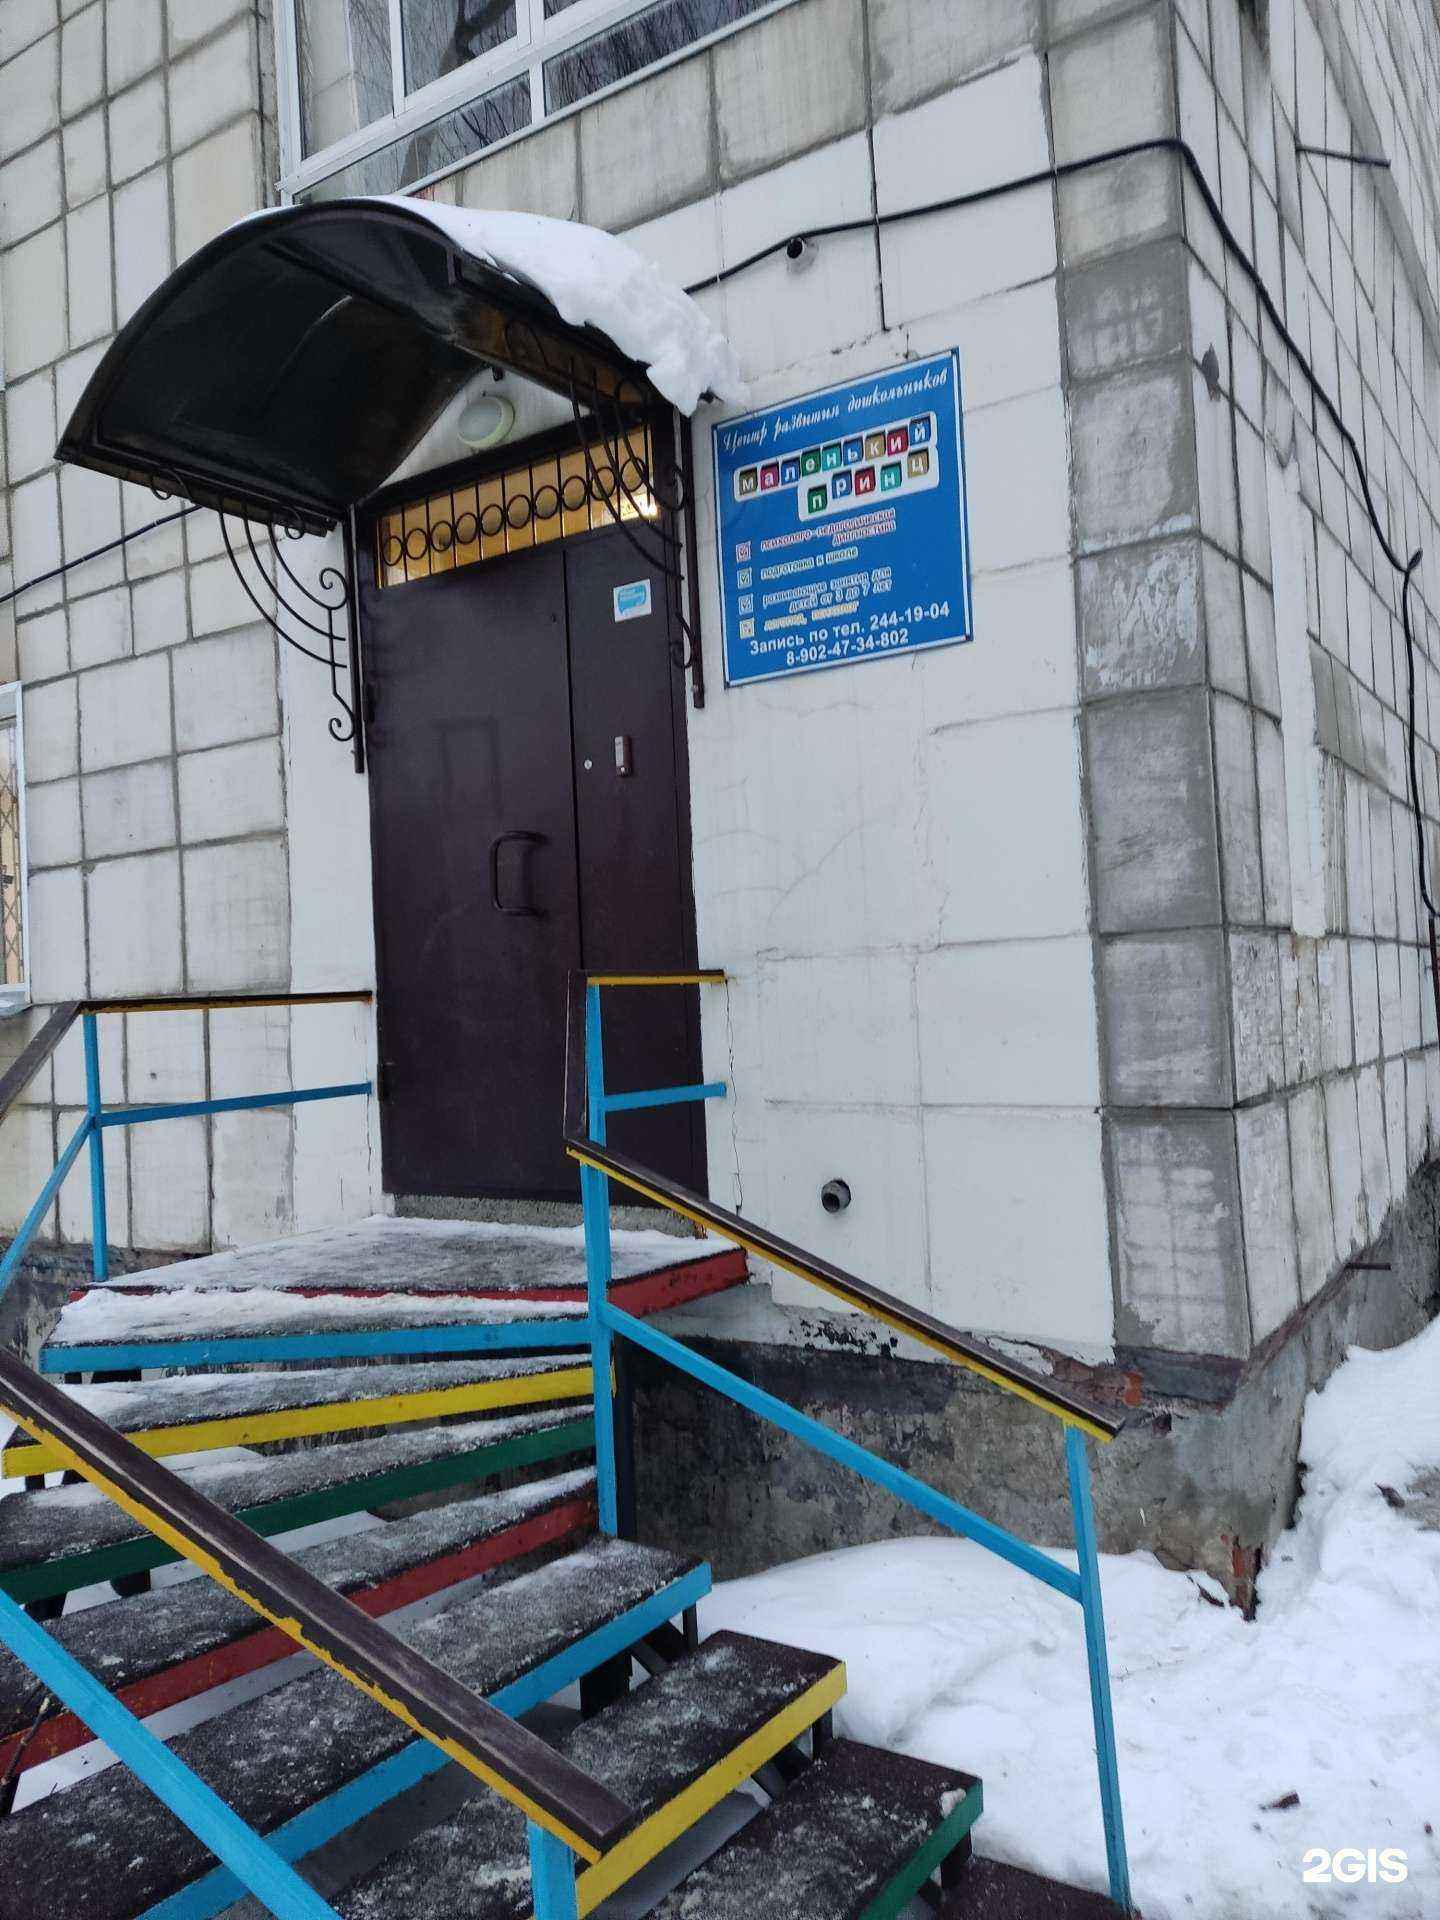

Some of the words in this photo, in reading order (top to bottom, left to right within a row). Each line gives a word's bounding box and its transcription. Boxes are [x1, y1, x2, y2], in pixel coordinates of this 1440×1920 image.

[723, 420, 767, 455] Центр
[774, 402, 841, 442] развития
[847, 367, 949, 414] дошкольников
[760, 557, 815, 580] подготовка
[825, 545, 859, 565] школе
[871, 566, 892, 584] для
[789, 593, 819, 613] детей
[845, 586, 860, 601] до
[861, 583, 871, 598] 7
[872, 579, 893, 595] лет
[750, 635, 805, 656] Запись
[809, 629, 828, 643] по
[832, 621, 865, 639] тел.
[869, 600, 951, 630] 244-19-04
[786, 628, 909, 666] 8-902-47-34-802
